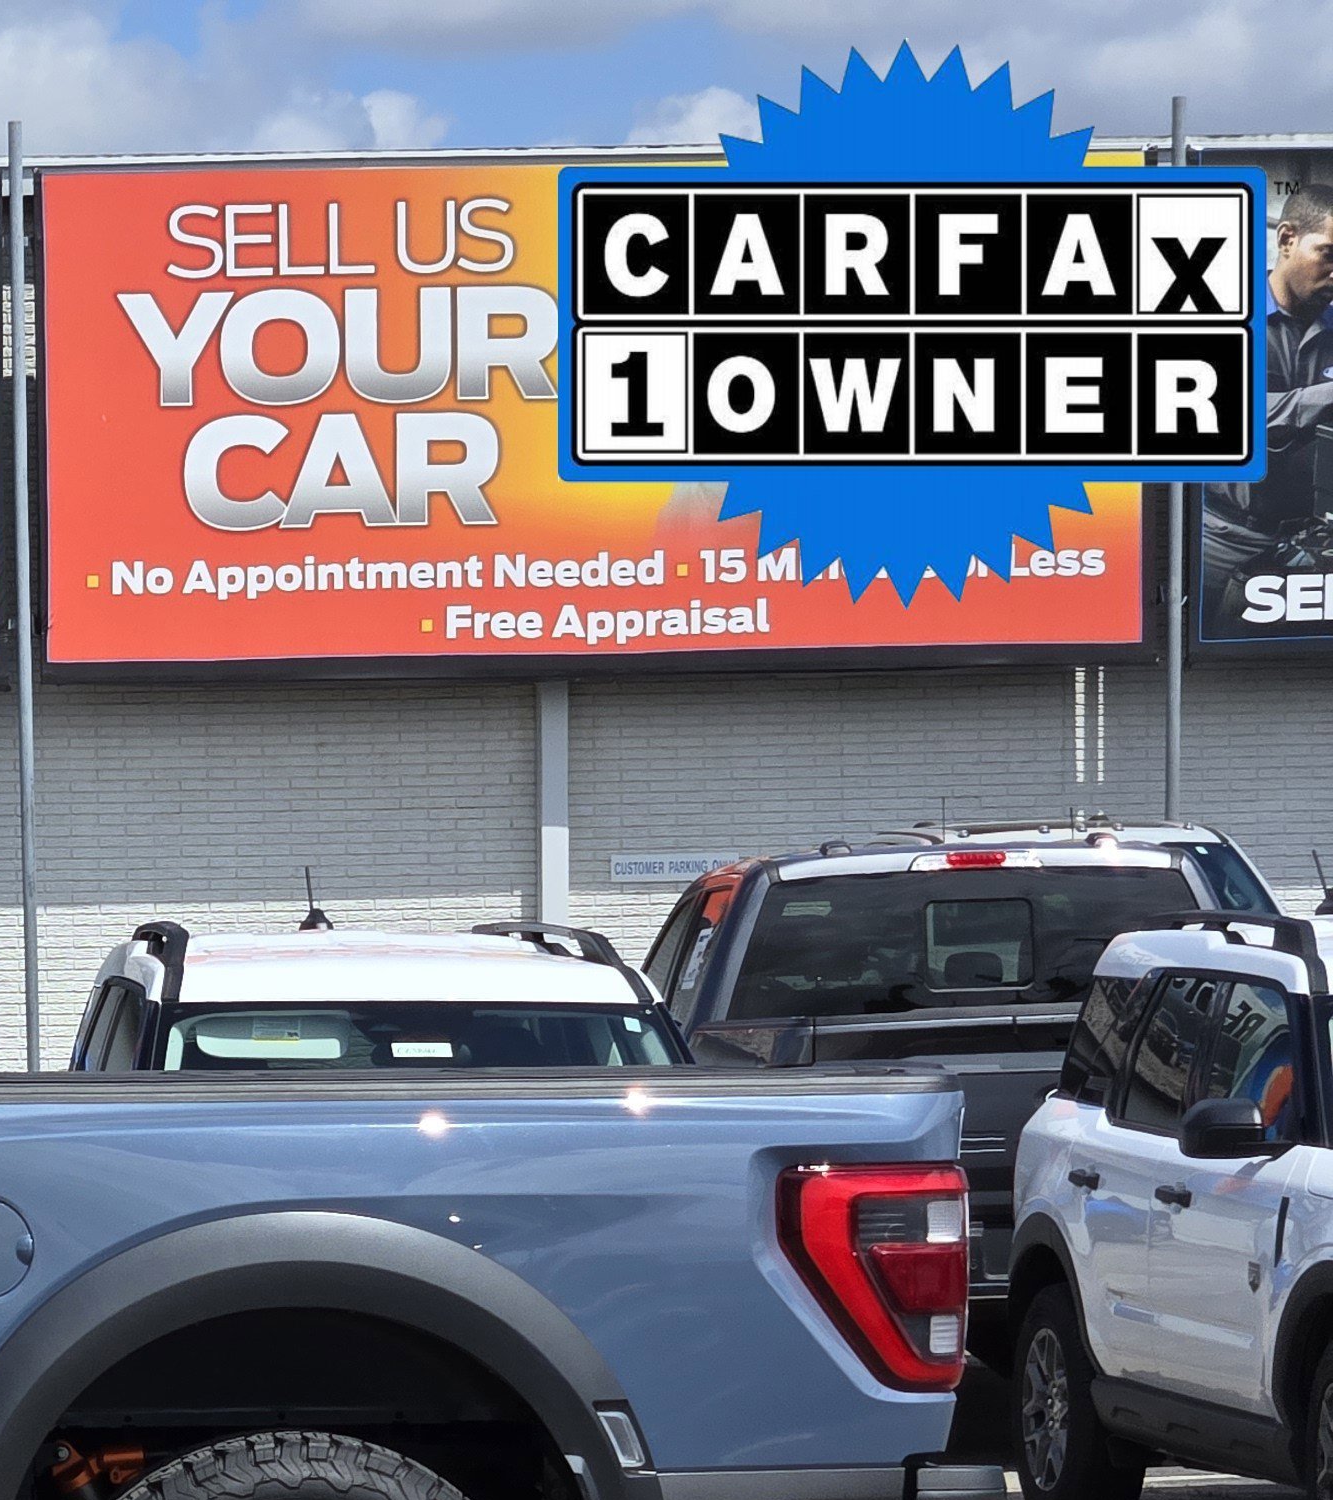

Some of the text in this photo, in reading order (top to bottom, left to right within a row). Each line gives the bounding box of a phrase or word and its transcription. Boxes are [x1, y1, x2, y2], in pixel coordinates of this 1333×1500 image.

[167, 198, 515, 279] SELL US
[116, 285, 559, 407] YOUR
[183, 412, 499, 532] CAR
[111, 560, 175, 596] No
[182, 555, 483, 601] Appointment
[493, 550, 665, 588] Needed
[699, 548, 747, 583] 15
[445, 598, 770, 645] Free Appraisal
[614, 861, 665, 875] CUSTOMER
[668, 859, 708, 873] PARKING
